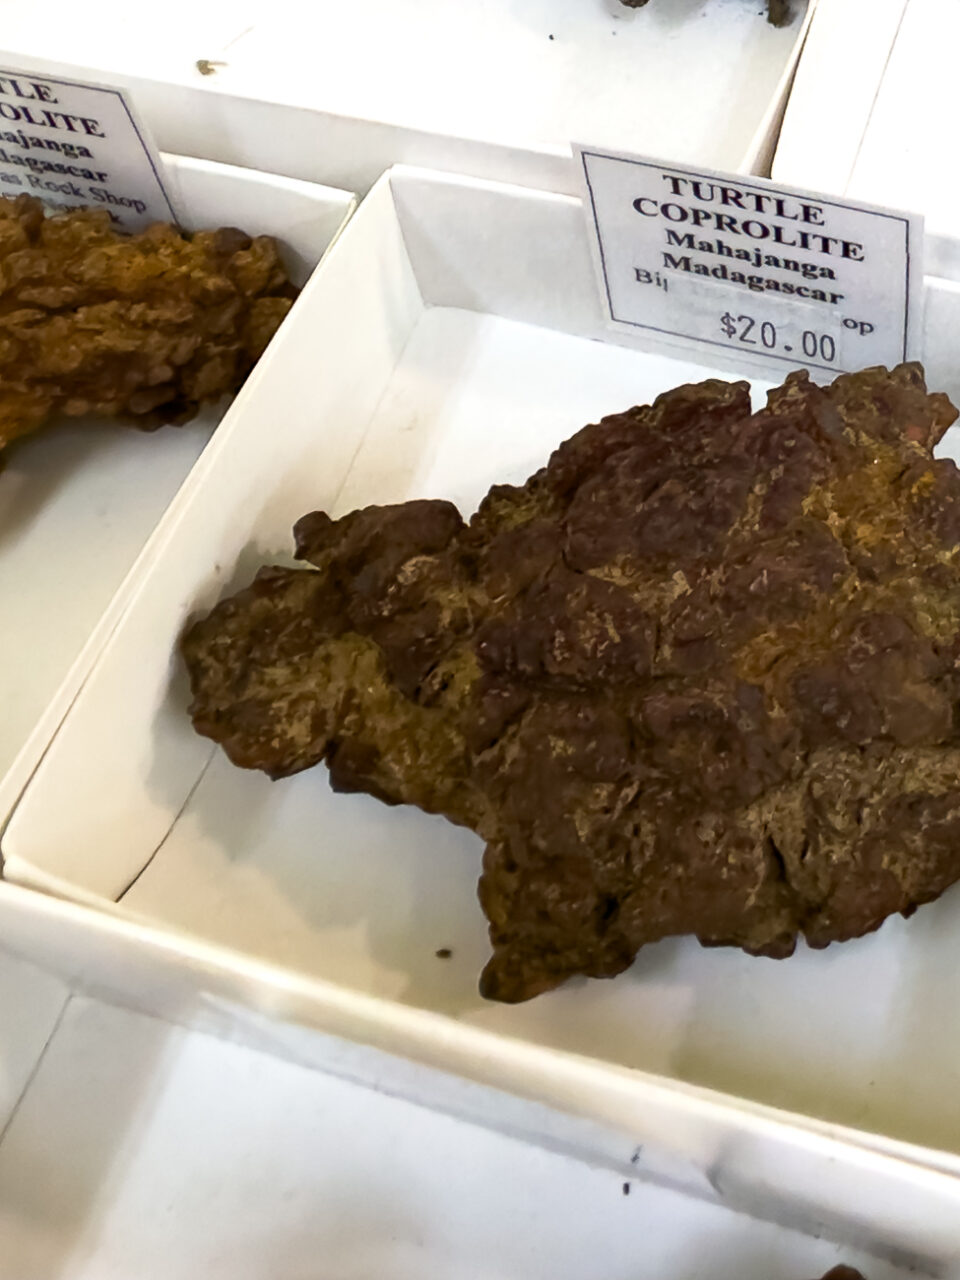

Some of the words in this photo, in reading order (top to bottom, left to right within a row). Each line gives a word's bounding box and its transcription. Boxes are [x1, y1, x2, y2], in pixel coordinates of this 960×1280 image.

[26, 174, 87, 199] Rock
[89, 187, 147, 215] Shop
[662, 174, 826, 227] TURTLE
[633, 198, 865, 262] COPROLITE
[665, 228, 837, 281] Mahajanga
[634, 267, 668, 291] Bi
[661, 252, 845, 305] Madagascar
[720, 312, 836, 362] $20.00
